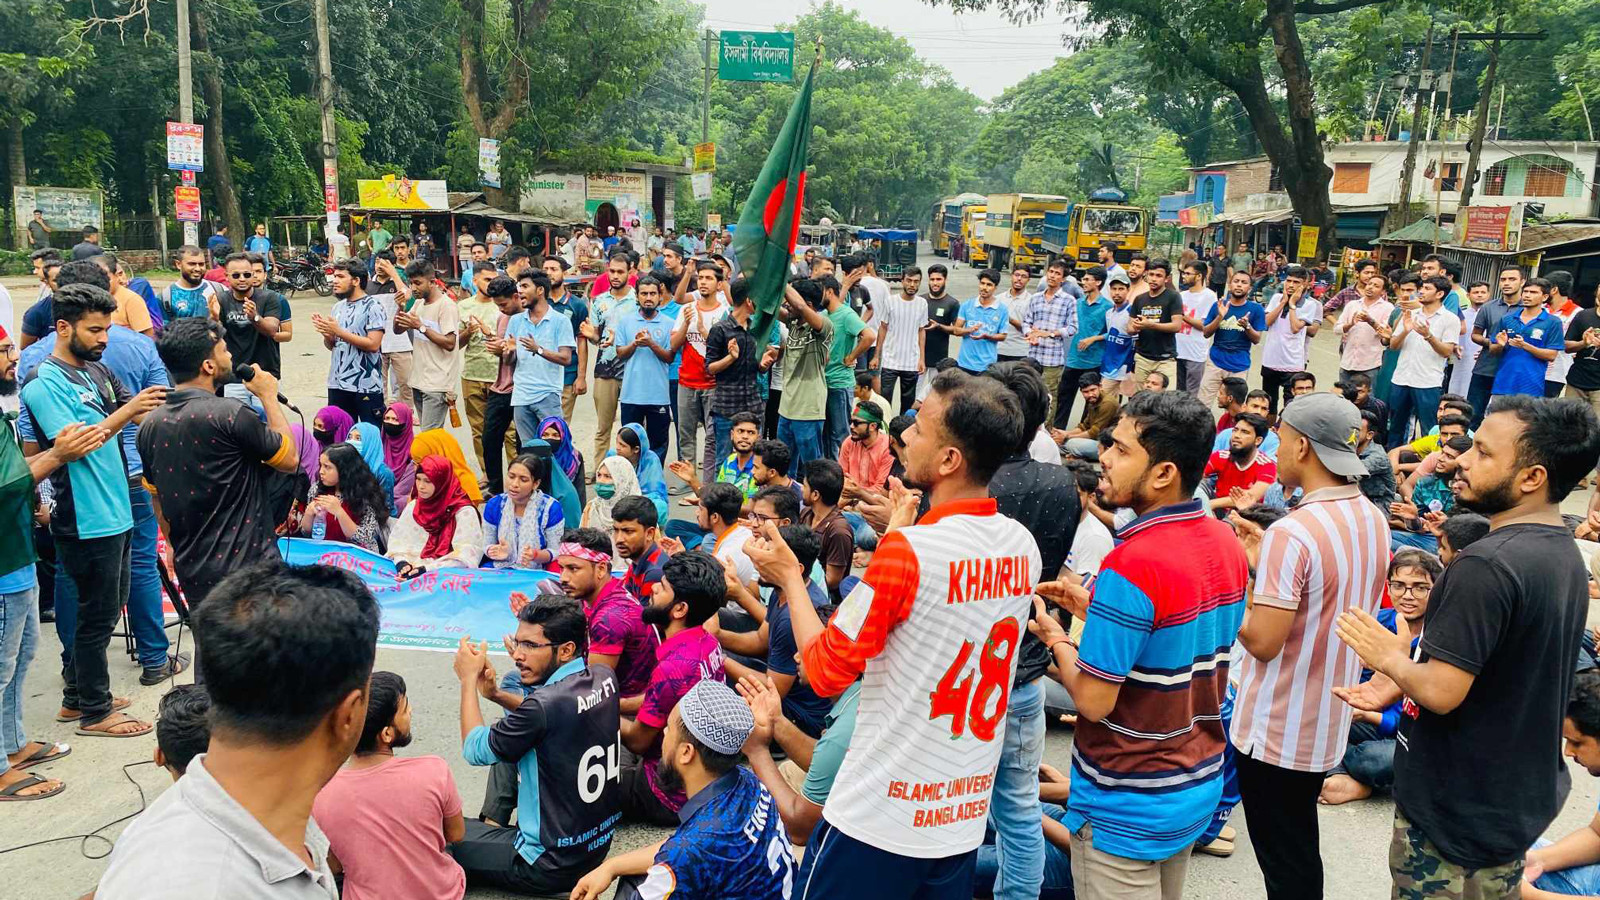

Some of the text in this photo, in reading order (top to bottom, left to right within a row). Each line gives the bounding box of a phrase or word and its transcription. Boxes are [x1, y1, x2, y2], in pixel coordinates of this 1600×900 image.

[724, 40, 789, 65] ইসলামী বিশ্ববিদ্যালয়
[947, 555, 1032, 604] KHAIRUL
[577, 676, 616, 714] Amir FT
[929, 616, 1019, 742] 48
[577, 729, 621, 804] 64
[888, 780, 945, 801] ISLAMIC
[557, 827, 598, 848] ISLAMIC
